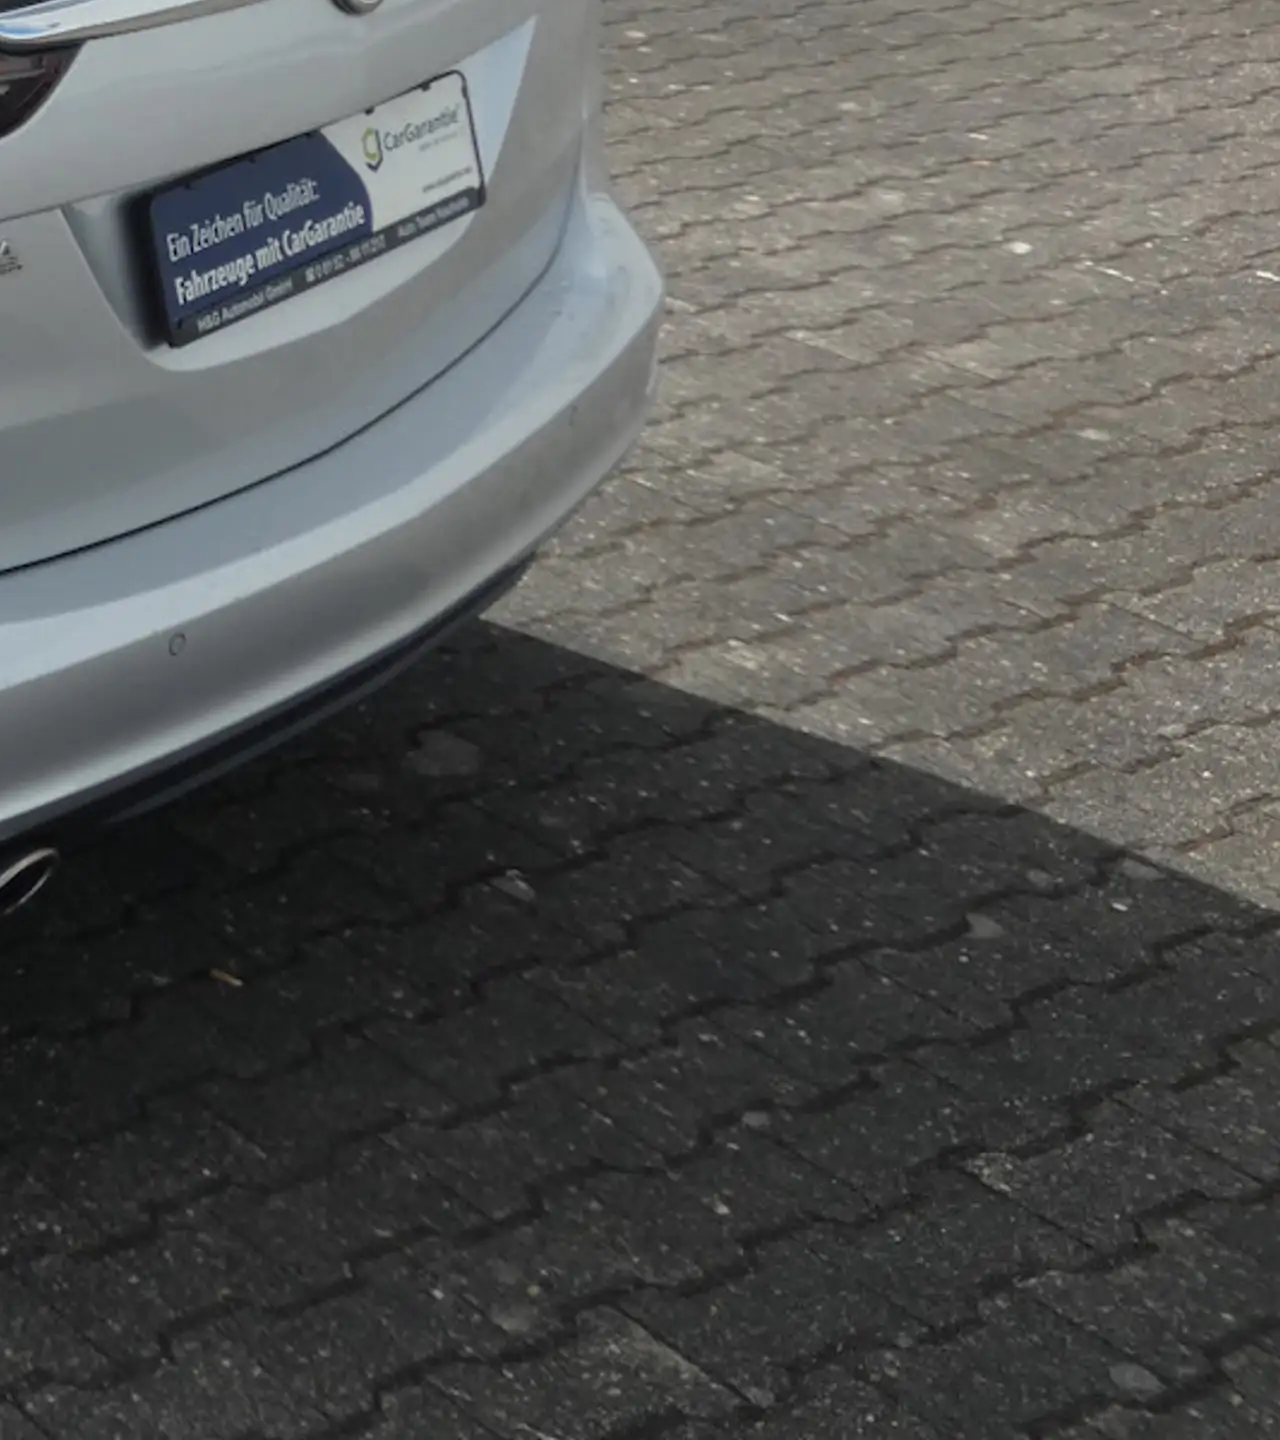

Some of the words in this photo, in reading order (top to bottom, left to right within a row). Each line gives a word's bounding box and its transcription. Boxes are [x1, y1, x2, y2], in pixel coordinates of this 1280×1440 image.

[166, 233, 191, 262] Ein
[190, 214, 244, 252] Zeichen
[242, 200, 265, 228] für
[174, 253, 255, 306] Fahrzeuge
[255, 236, 284, 271] mit
[282, 201, 366, 256] CarGarantie
